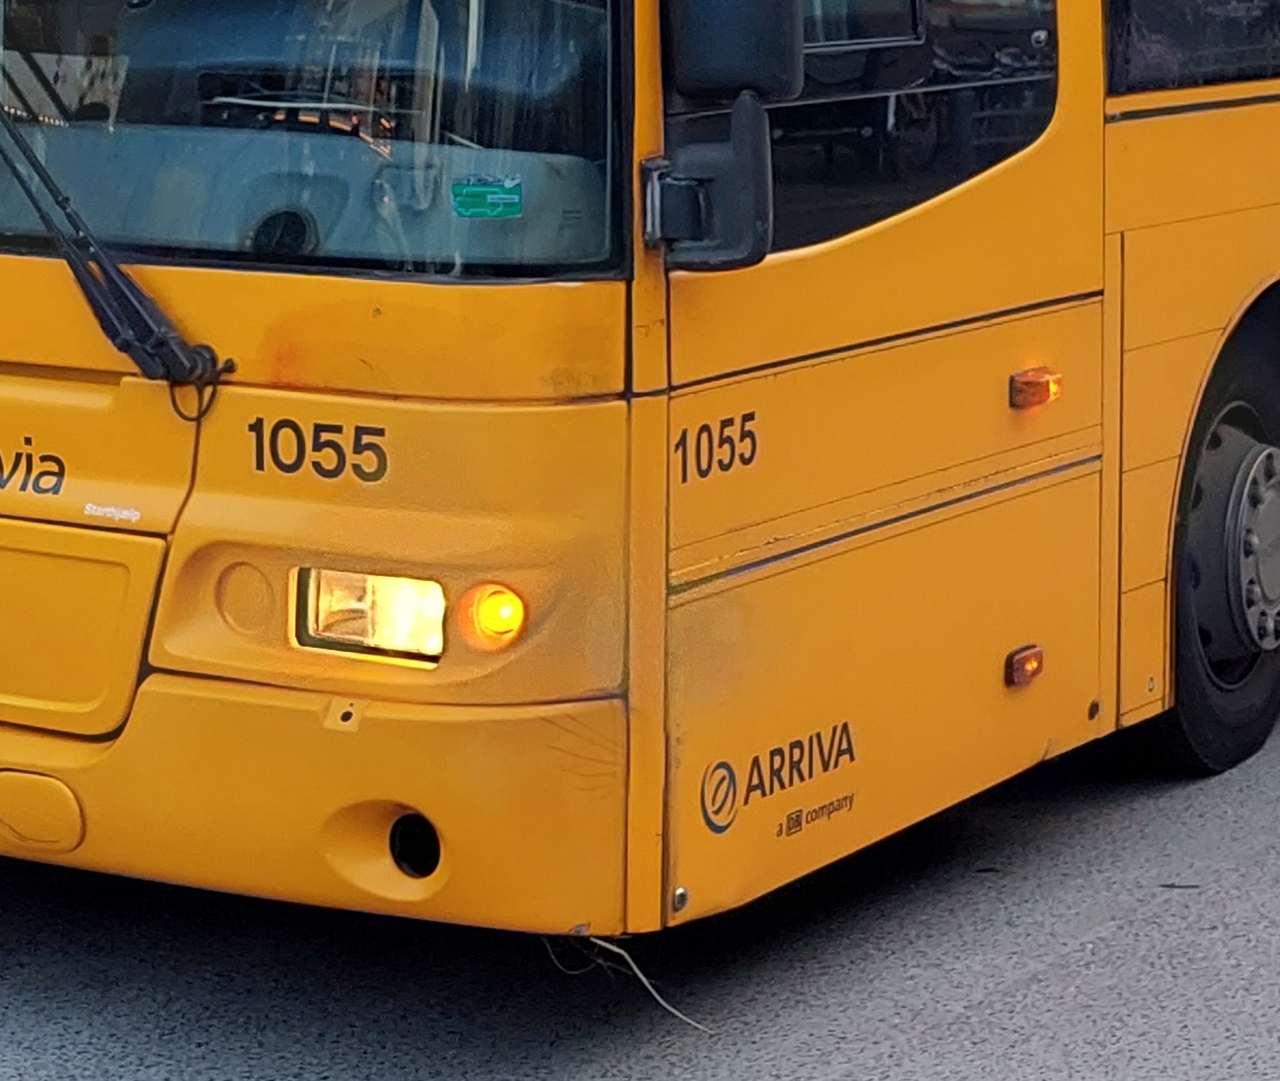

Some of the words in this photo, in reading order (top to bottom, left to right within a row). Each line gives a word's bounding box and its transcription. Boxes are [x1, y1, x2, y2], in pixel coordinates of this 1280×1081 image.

[247, 416, 388, 483] 1055
[674, 411, 758, 484] 1055
[742, 720, 856, 807] ARRIVA
[805, 793, 855, 825] company
